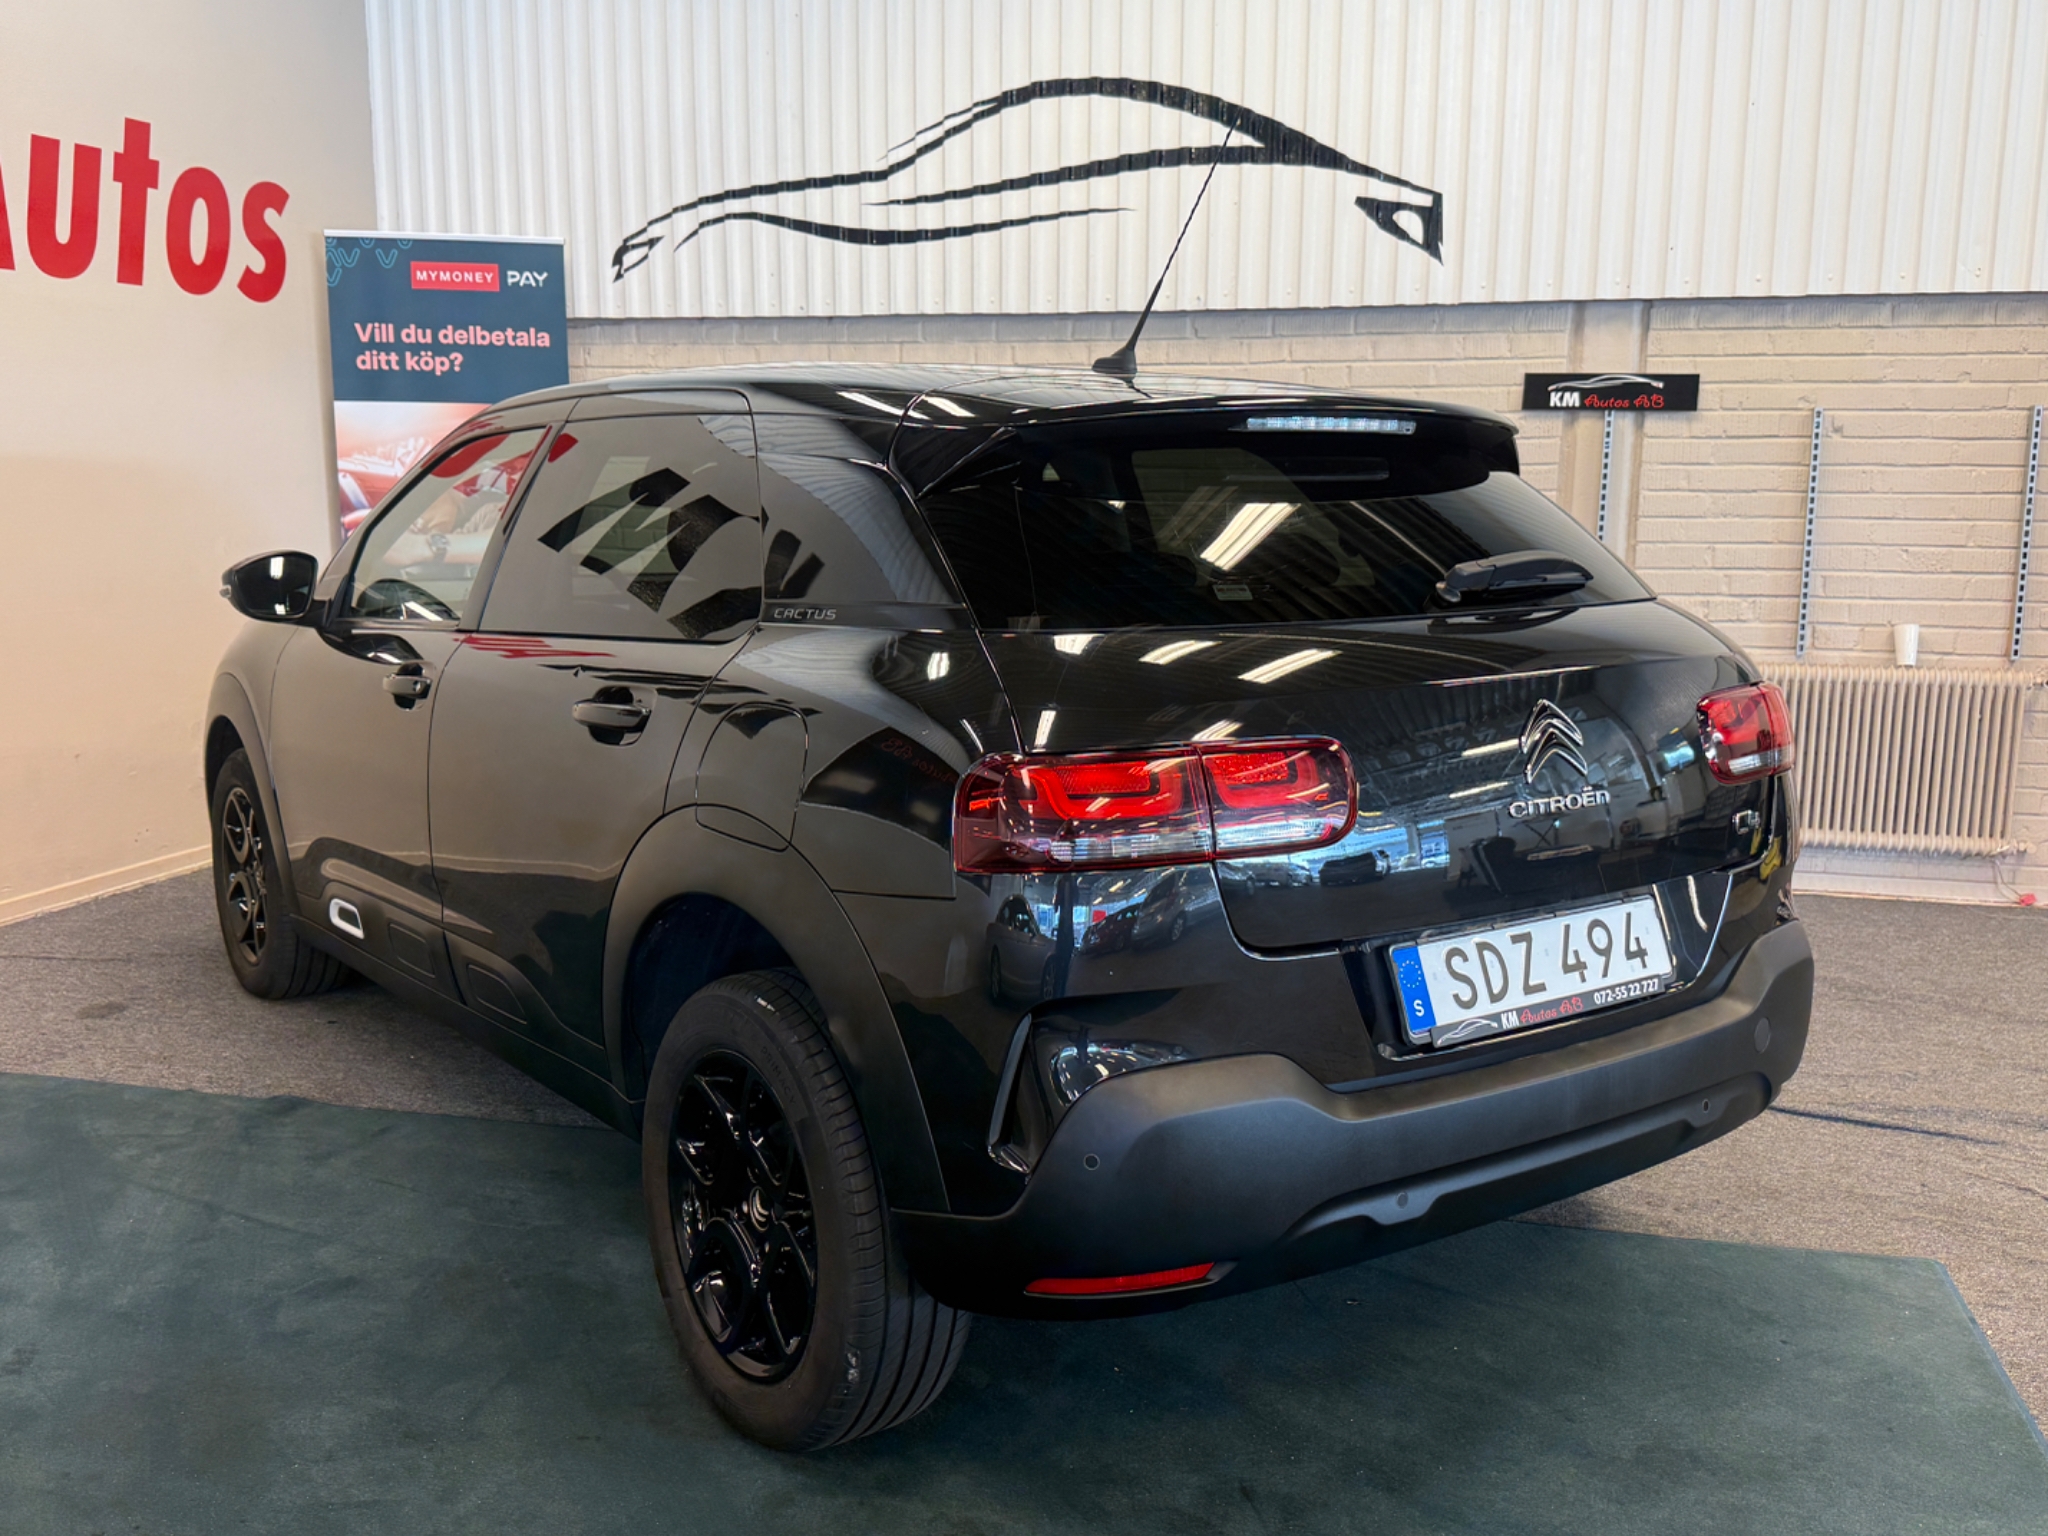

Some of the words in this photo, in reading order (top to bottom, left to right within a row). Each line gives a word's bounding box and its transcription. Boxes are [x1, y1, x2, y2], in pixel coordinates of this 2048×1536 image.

[0, 117, 290, 303] utos
[416, 270, 494, 283] MYMONEY
[507, 271, 548, 287] PAY
[354, 323, 395, 344] Vill
[401, 324, 433, 344] du
[438, 325, 551, 348] delbetala
[356, 350, 400, 371] ditt
[405, 351, 464, 376] köp?
[1549, 391, 1581, 408] KM
[1584, 394, 1630, 409] Autos
[773, 608, 837, 620] CACTUS
[1444, 931, 1547, 1010] SDZ
[1561, 911, 1649, 984] 494
[1413, 999, 1425, 1018] S
[1501, 1010, 1520, 1030] KM
[1520, 1008, 1557, 1024] Autos
[759, 1045, 797, 1105] PRIMACY
